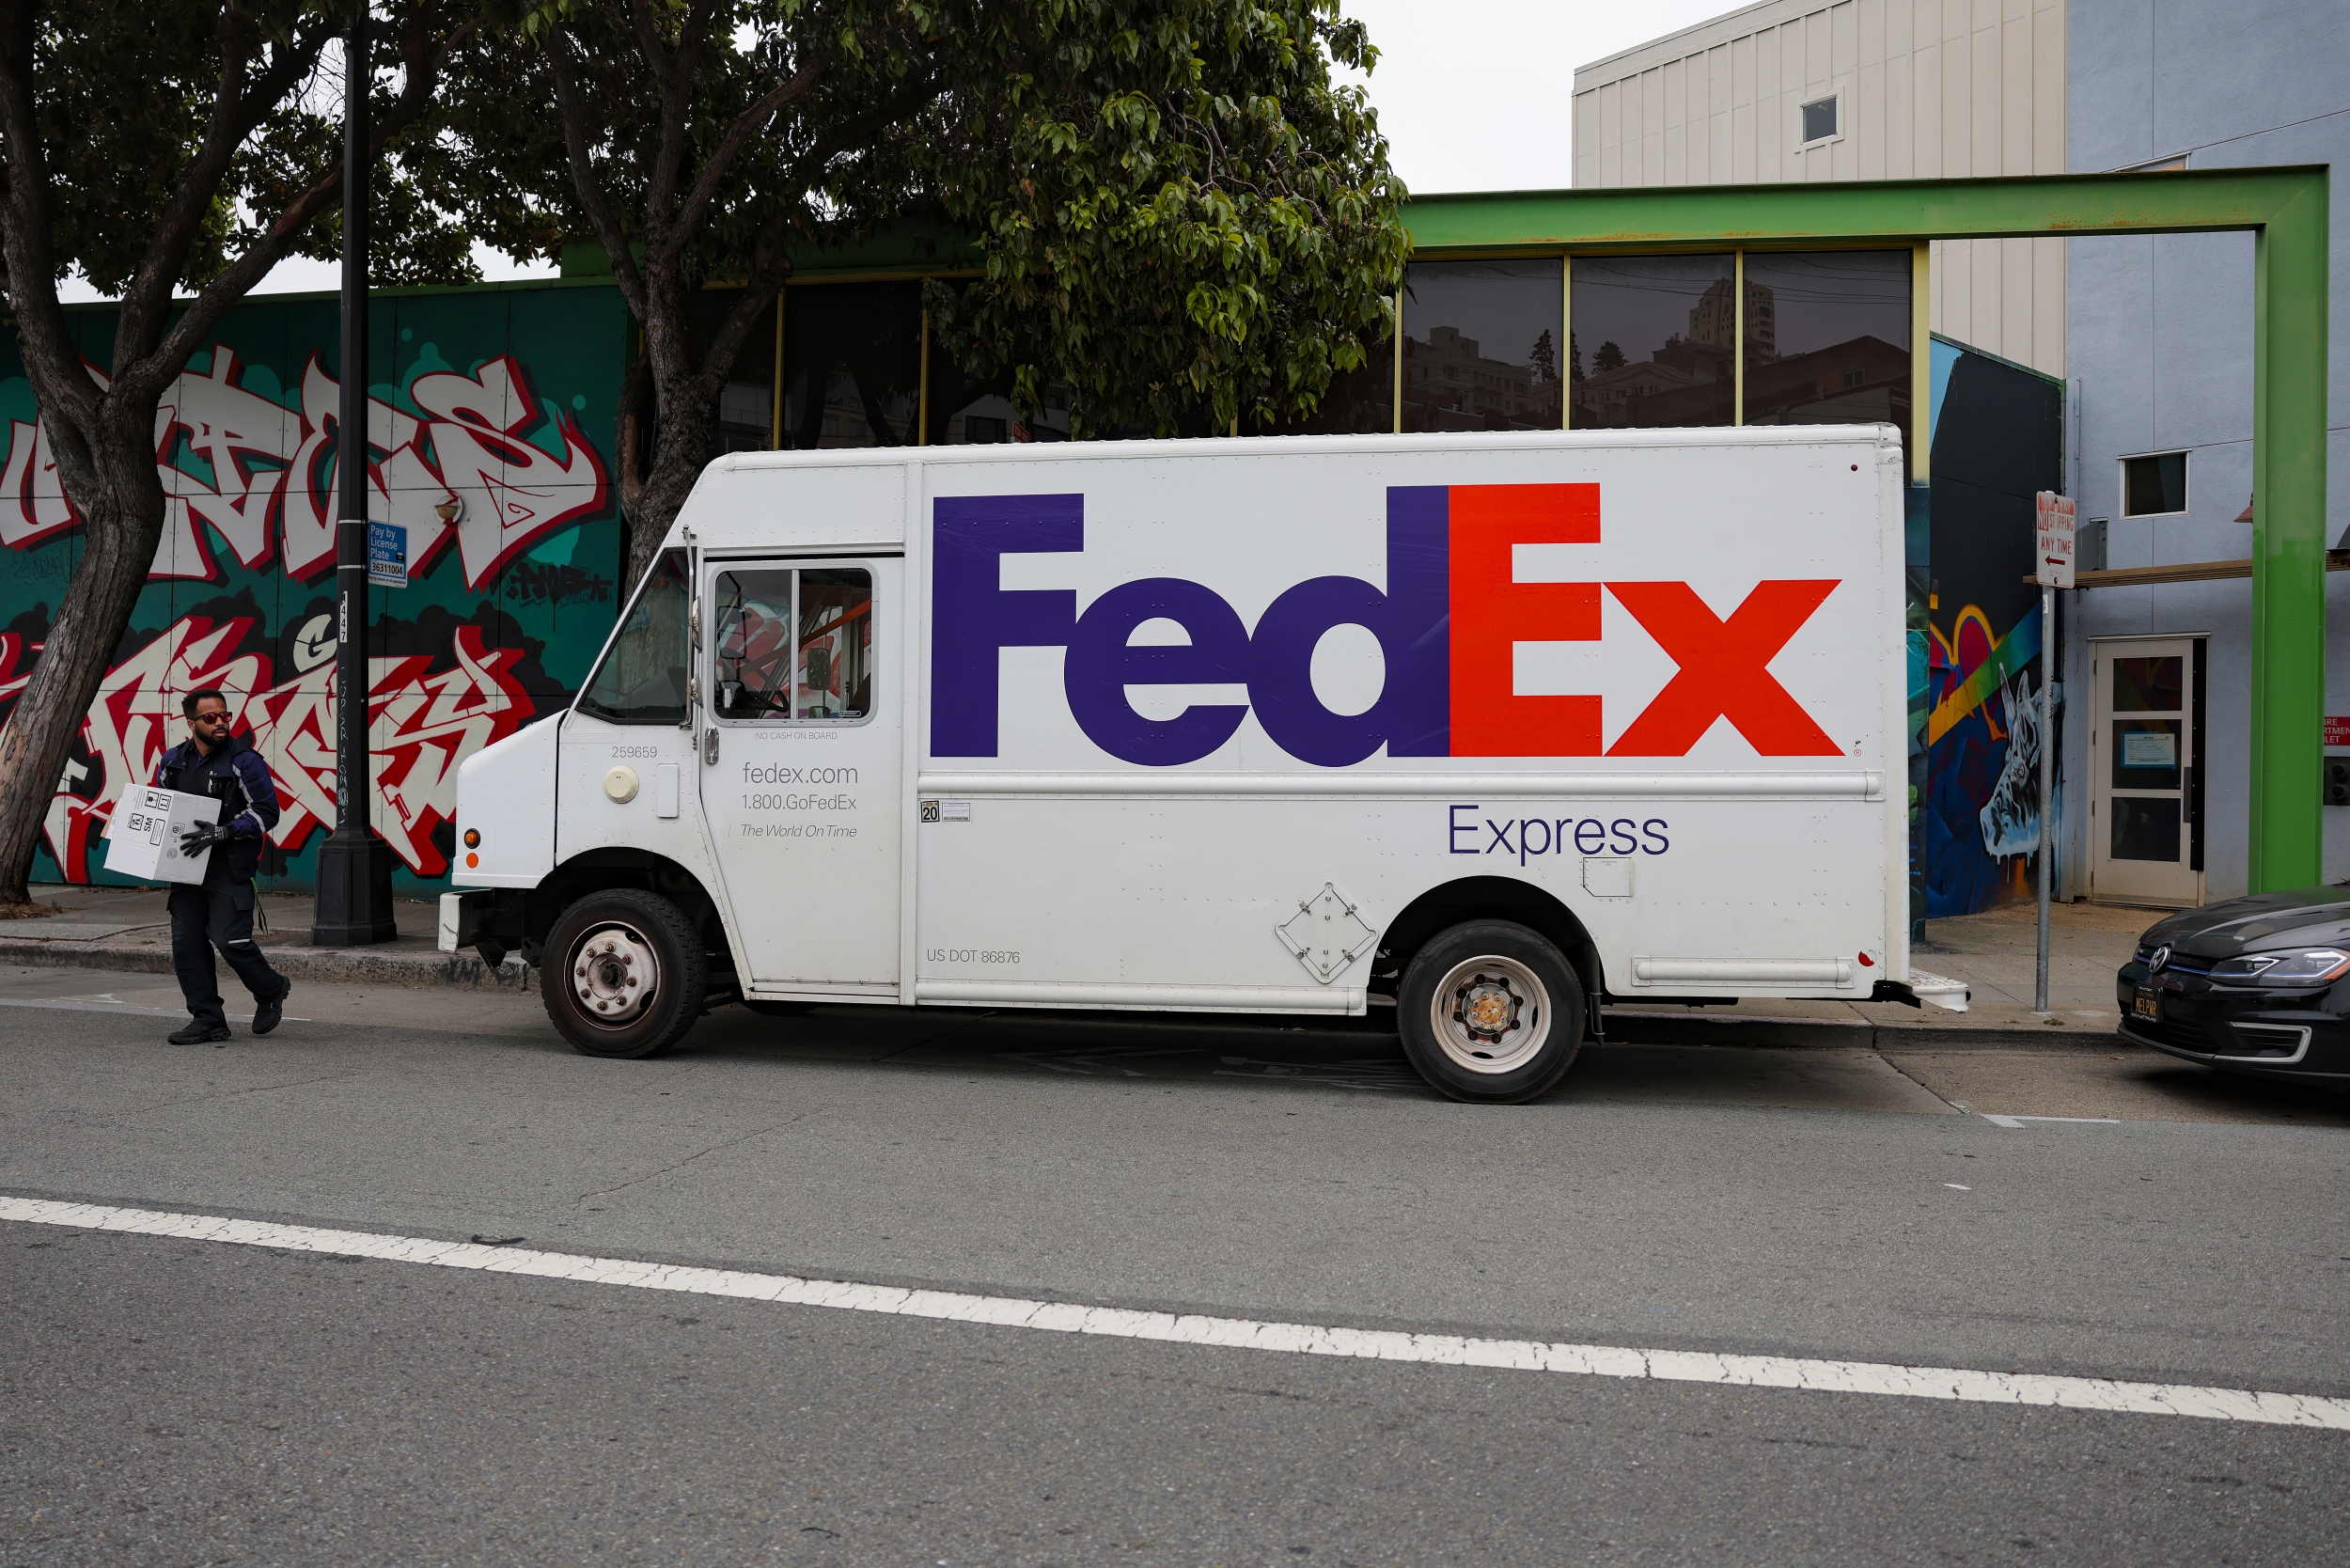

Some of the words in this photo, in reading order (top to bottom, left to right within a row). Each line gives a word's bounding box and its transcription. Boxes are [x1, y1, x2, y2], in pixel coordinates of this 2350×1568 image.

[2038, 510, 2048, 530] NO
[370, 525, 384, 539] Pay
[386, 527, 396, 541] by
[370, 536, 398, 550] License
[2041, 536, 2055, 552] ANY
[2057, 539, 2072, 555] TIME
[370, 548, 389, 560] Plate
[371, 562, 403, 575] 36311004
[932, 481, 1845, 767] FedEx
[755, 731, 768, 740] NO
[770, 731, 792, 740] CASH
[794, 731, 807, 740] ON
[808, 731, 838, 740] BOARD
[611, 746, 658, 759] 259659
[743, 761, 858, 784] fedex.com
[741, 793, 857, 810] 1.800.GoFedEx
[922, 807, 938, 821] 20
[144, 817, 153, 832] SM
[741, 823, 763, 838] The
[765, 823, 803, 838] World
[805, 824, 824, 838] On
[826, 824, 857, 838] Time
[1449, 805, 1669, 867] Express
[927, 949, 946, 962] US
[949, 949, 978, 963] DOT
[980, 950, 1021, 964] 86876
[2135, 996, 2157, 1017] MELPWR
